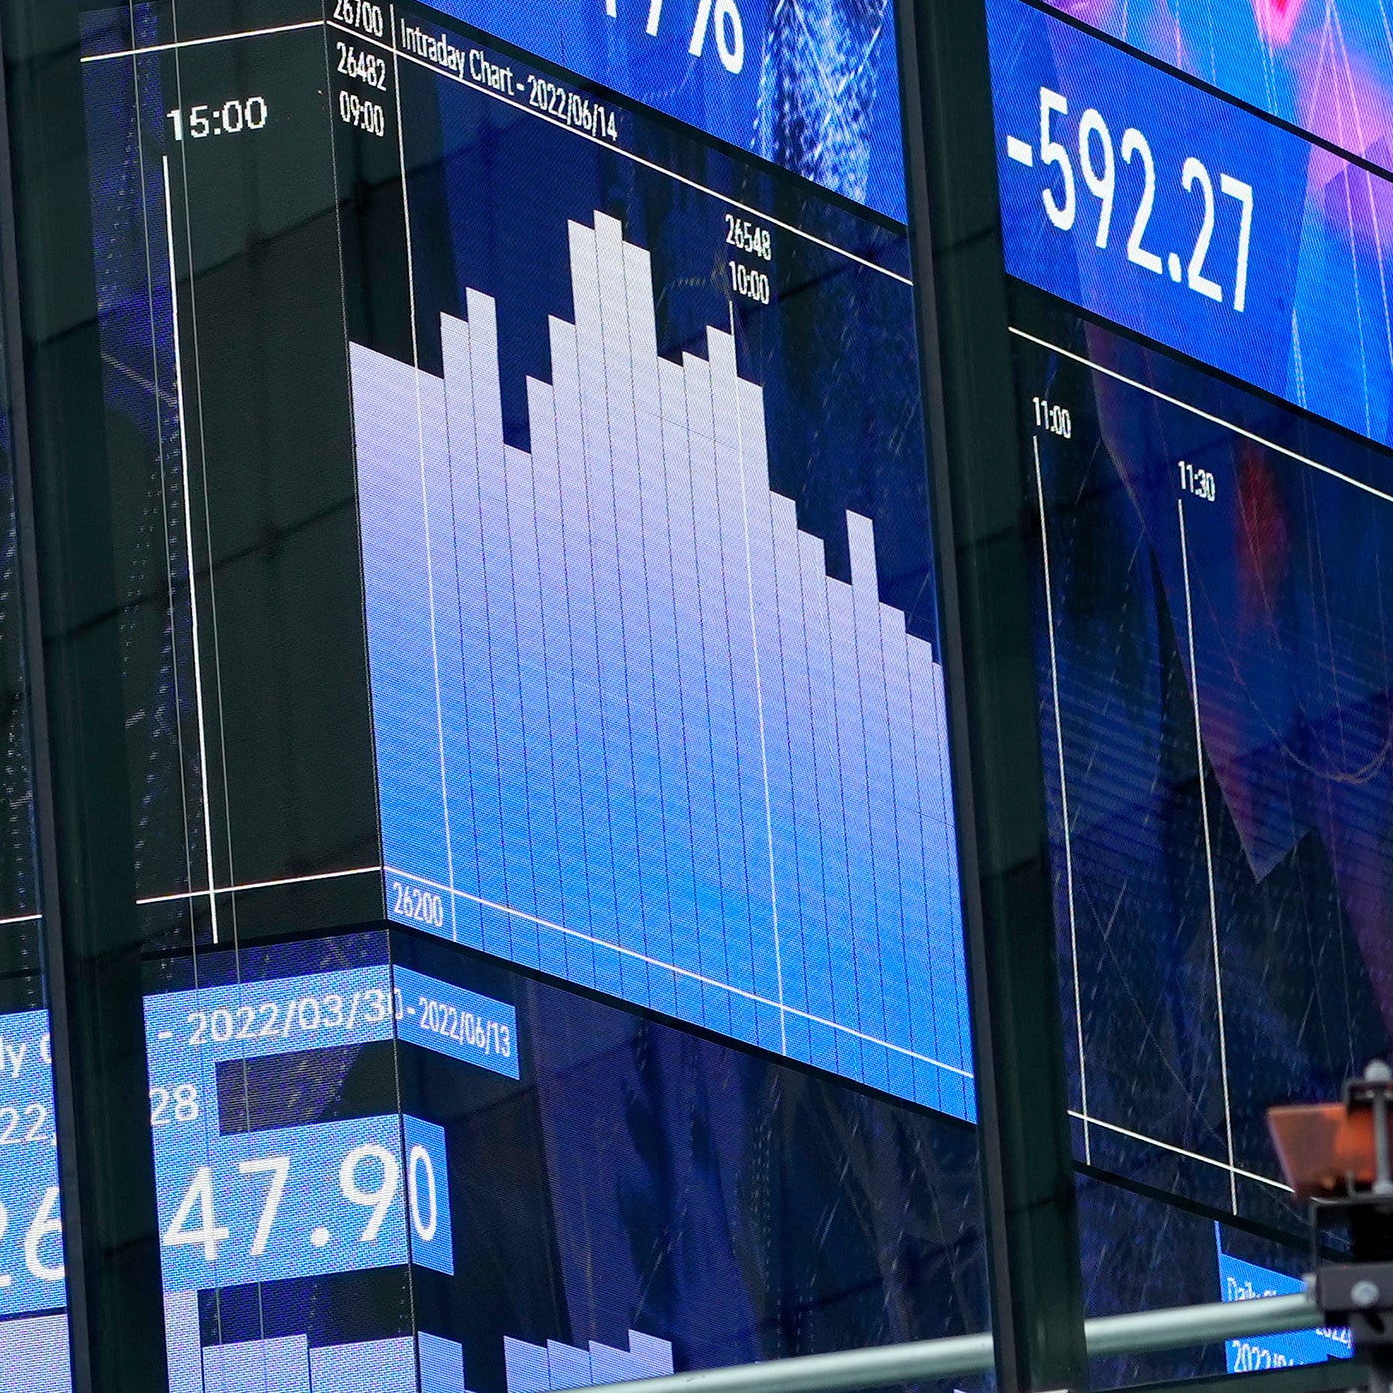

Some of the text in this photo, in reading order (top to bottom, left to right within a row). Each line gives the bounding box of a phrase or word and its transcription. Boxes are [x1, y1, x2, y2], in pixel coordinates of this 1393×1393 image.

[337, 41, 388, 90] 26482
[401, 18, 465, 79] Intraday
[469, 49, 514, 96] Chart
[526, 76, 617, 142] 2022/06/14
[167, 97, 267, 140] 15:00
[340, 91, 384, 136] 09:00
[1007, 87, 1253, 311] -592.27
[726, 213, 772, 260] 26548
[729, 261, 769, 304] 10:00
[1033, 398, 1071, 438] 11:00
[1179, 461, 1215, 501] 11:30
[393, 883, 444, 927] 26200
[419, 996, 511, 1057] 2022/06/13
